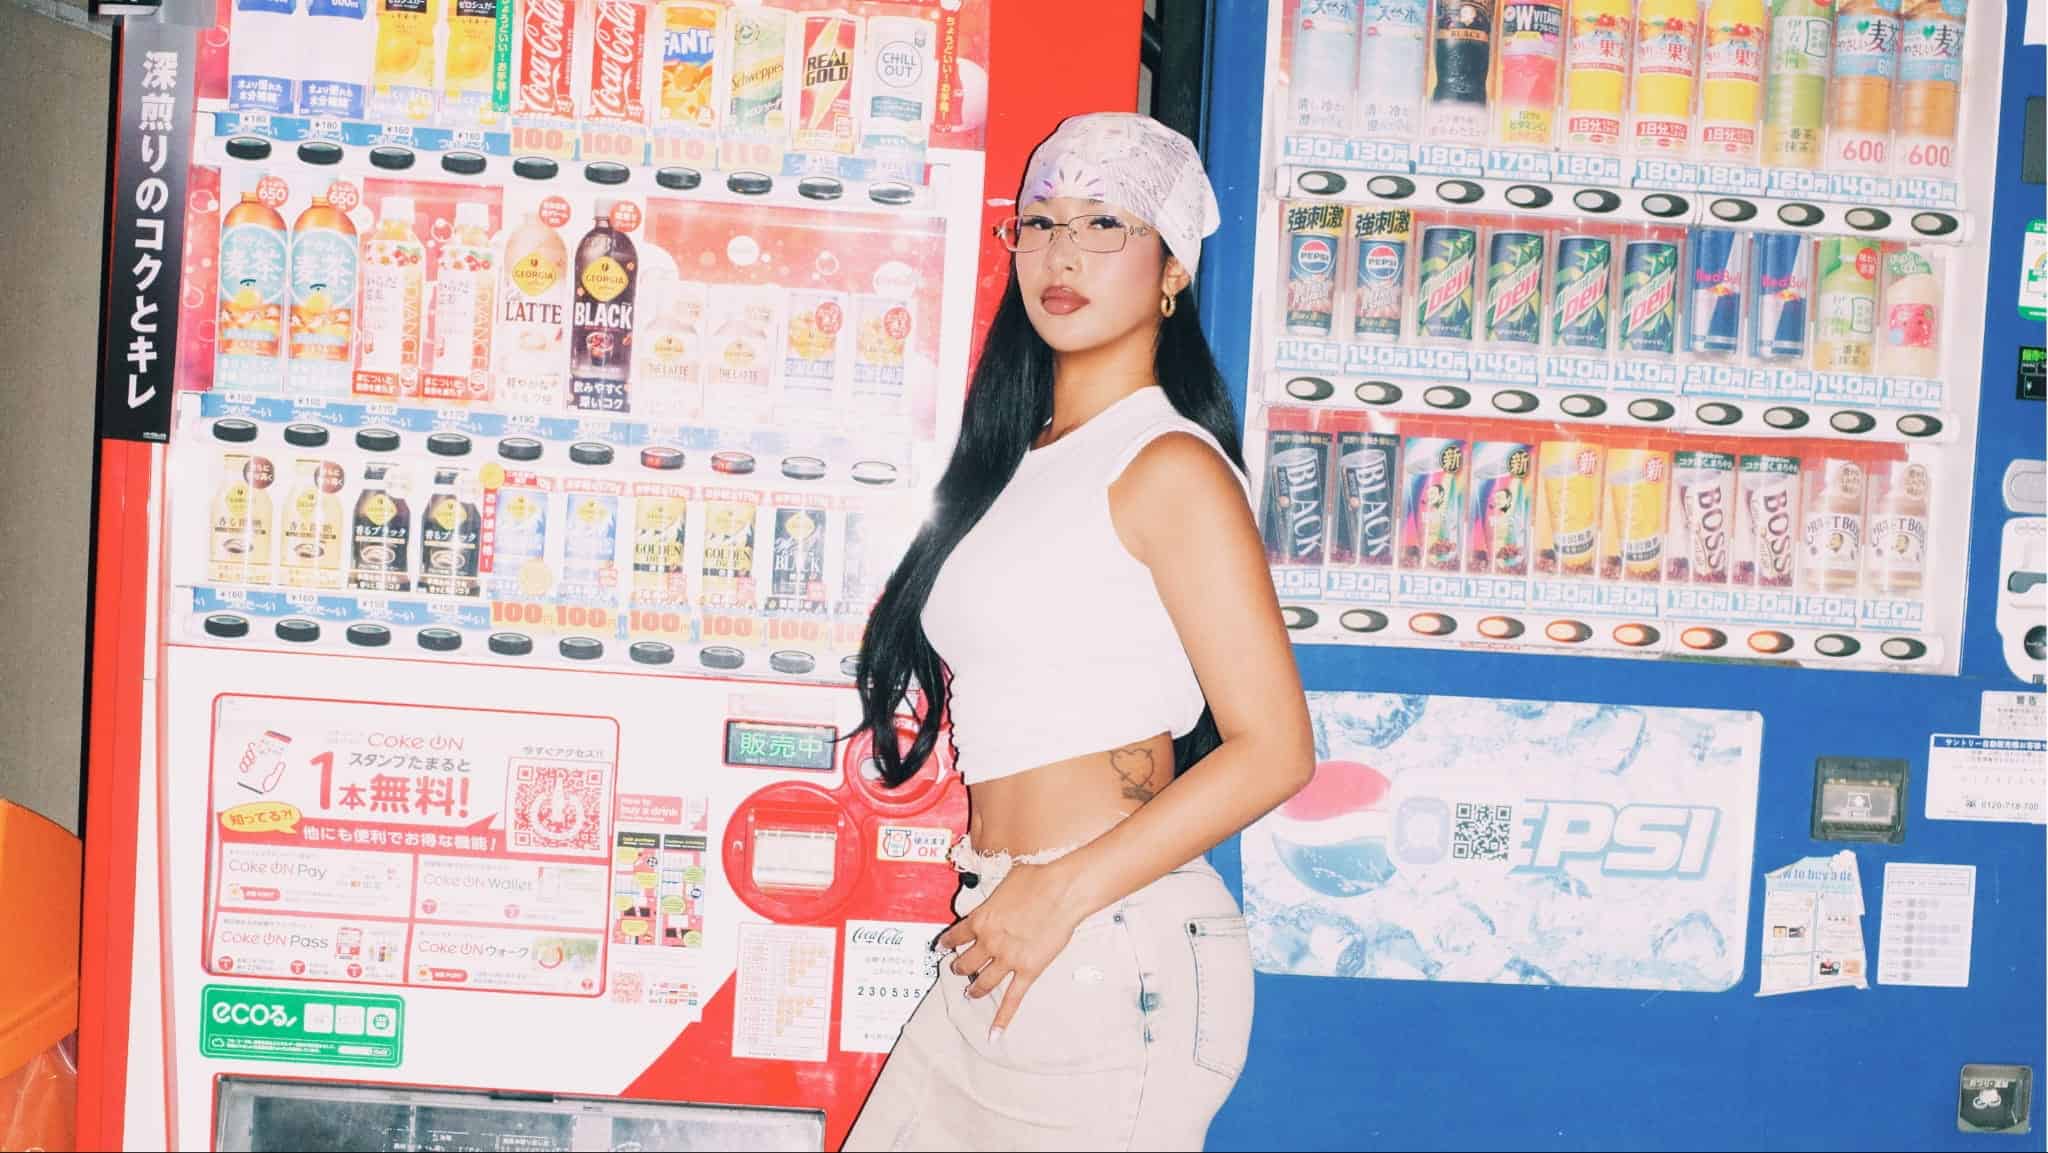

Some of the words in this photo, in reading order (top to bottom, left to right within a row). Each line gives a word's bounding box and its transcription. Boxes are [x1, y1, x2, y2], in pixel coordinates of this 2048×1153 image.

[807, 51, 849, 68] REAL
[882, 52, 918, 67] CHILL
[806, 66, 848, 86] GOLD
[884, 65, 913, 79] OUT
[1288, 138, 1346, 158] 130円
[1350, 142, 1409, 162] 130円
[1423, 147, 1481, 167] 180円
[1842, 139, 1884, 163] 600
[1909, 144, 1951, 168] 600
[1491, 151, 1549, 171] 170円
[1561, 156, 1620, 176] 180円
[1637, 161, 1697, 182] 180円
[1700, 166, 1760, 186] 180円
[1832, 175, 1892, 197] 140円
[1287, 205, 1344, 231] 強刺激
[1354, 209, 1412, 237] 強刺激
[127, 50, 178, 409] 深煎りのコクとキレ
[1300, 250, 1331, 261] PEPSI
[1368, 256, 1398, 267] PEPSI
[505, 302, 563, 325] LATTE
[574, 303, 634, 329] BLACK
[1410, 350, 1468, 370] 140円
[1475, 354, 1537, 375] 140円
[1549, 358, 1608, 380] 140円
[1615, 361, 1676, 384] 140円
[1686, 366, 1747, 386] 210円
[1751, 369, 1811, 390] 210円
[1816, 374, 1878, 396] 140円
[1441, 447, 1463, 473] 新
[1509, 451, 1531, 477] 新
[1287, 457, 1322, 556] BLACK
[1356, 459, 1392, 556] BLACK
[1697, 486, 1727, 569] BOSS
[1763, 490, 1792, 574] BOSS
[1328, 572, 1389, 593] 130円
[1402, 576, 1464, 597] 130円
[1465, 578, 1525, 599] 130円
[1601, 586, 1657, 607] 130円
[1671, 590, 1729, 611] 130円
[1738, 593, 1792, 613] 130円
[368, 731, 424, 750] Coke
[740, 732, 824, 759] 販売中
[349, 752, 471, 772] スタンプたまると
[309, 751, 471, 820] 1本無料!
[303, 825, 497, 851] 他にも便利でお得な機能!
[228, 859, 268, 874] Coke
[297, 863, 328, 881] Pay
[221, 931, 261, 946] Coke
[289, 934, 329, 949] Pass
[417, 939, 459, 955] Coke
